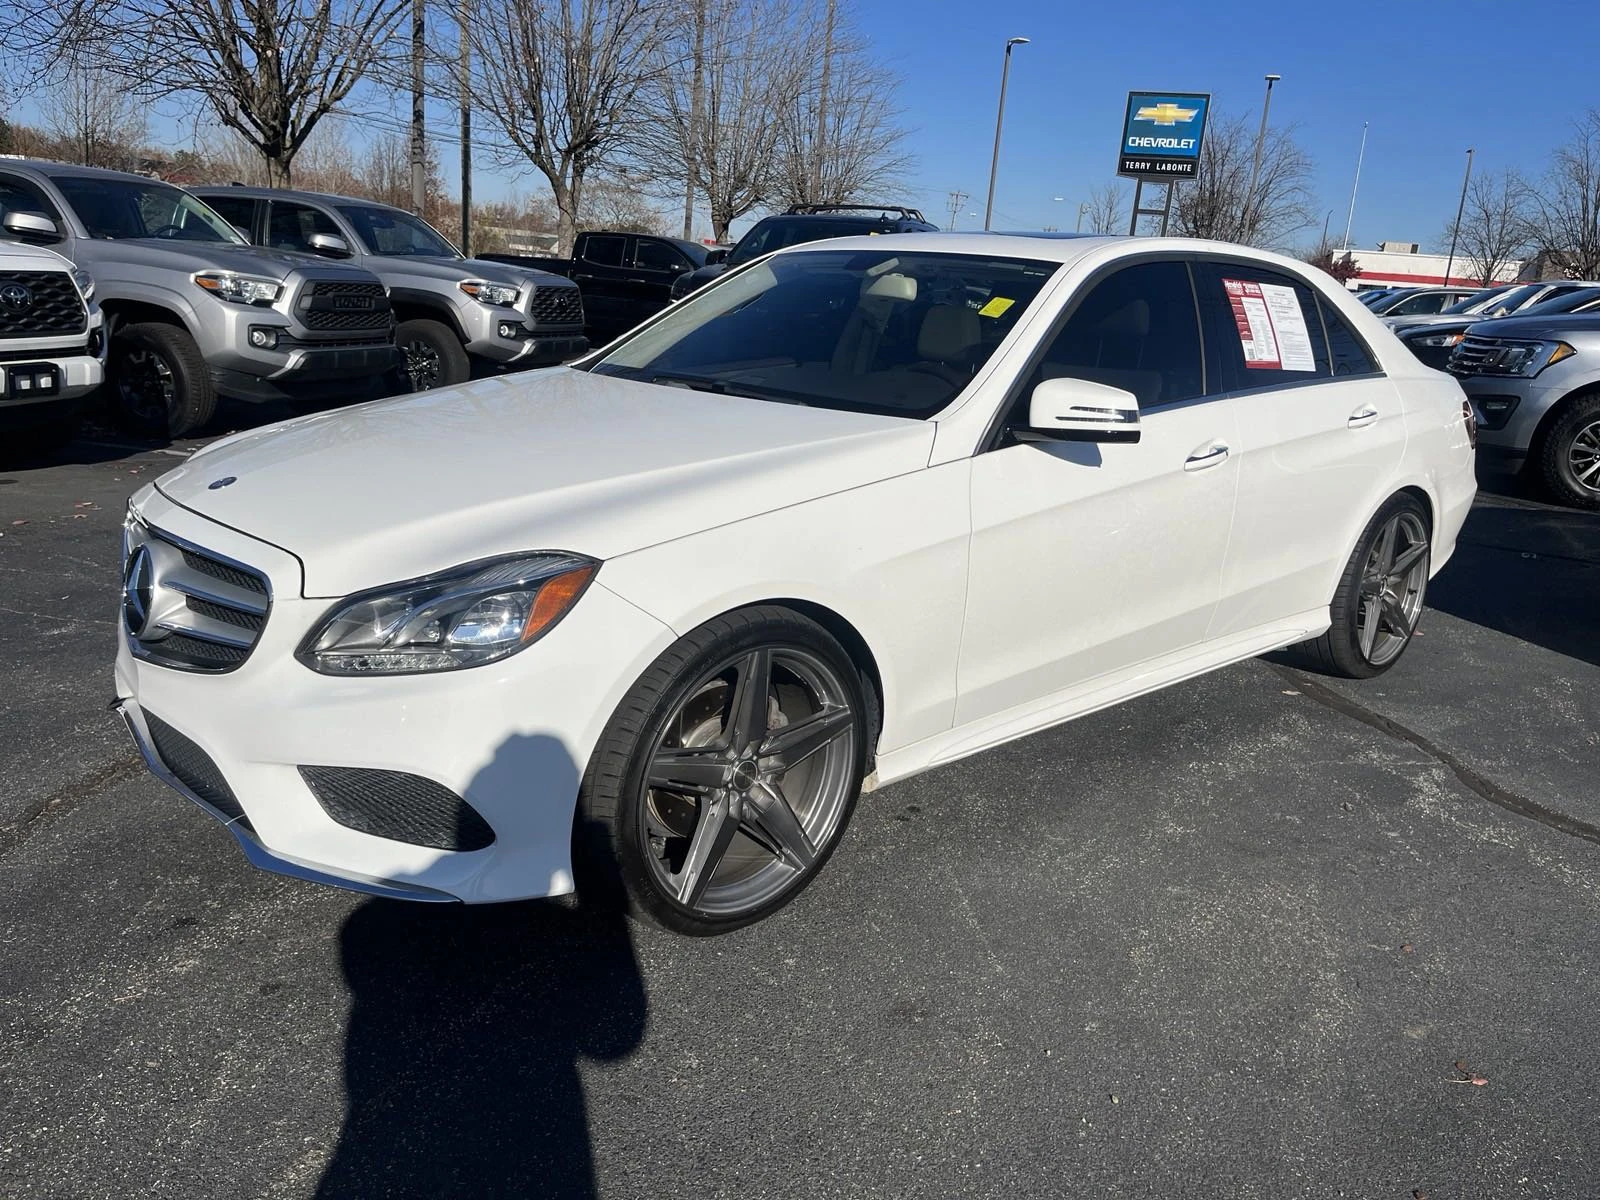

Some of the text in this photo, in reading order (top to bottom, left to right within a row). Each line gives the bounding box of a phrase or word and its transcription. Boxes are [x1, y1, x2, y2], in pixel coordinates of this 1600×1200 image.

[1128, 136, 1196, 149] CHEVROLET
[1125, 161, 1192, 172] TERRY LABONTE
